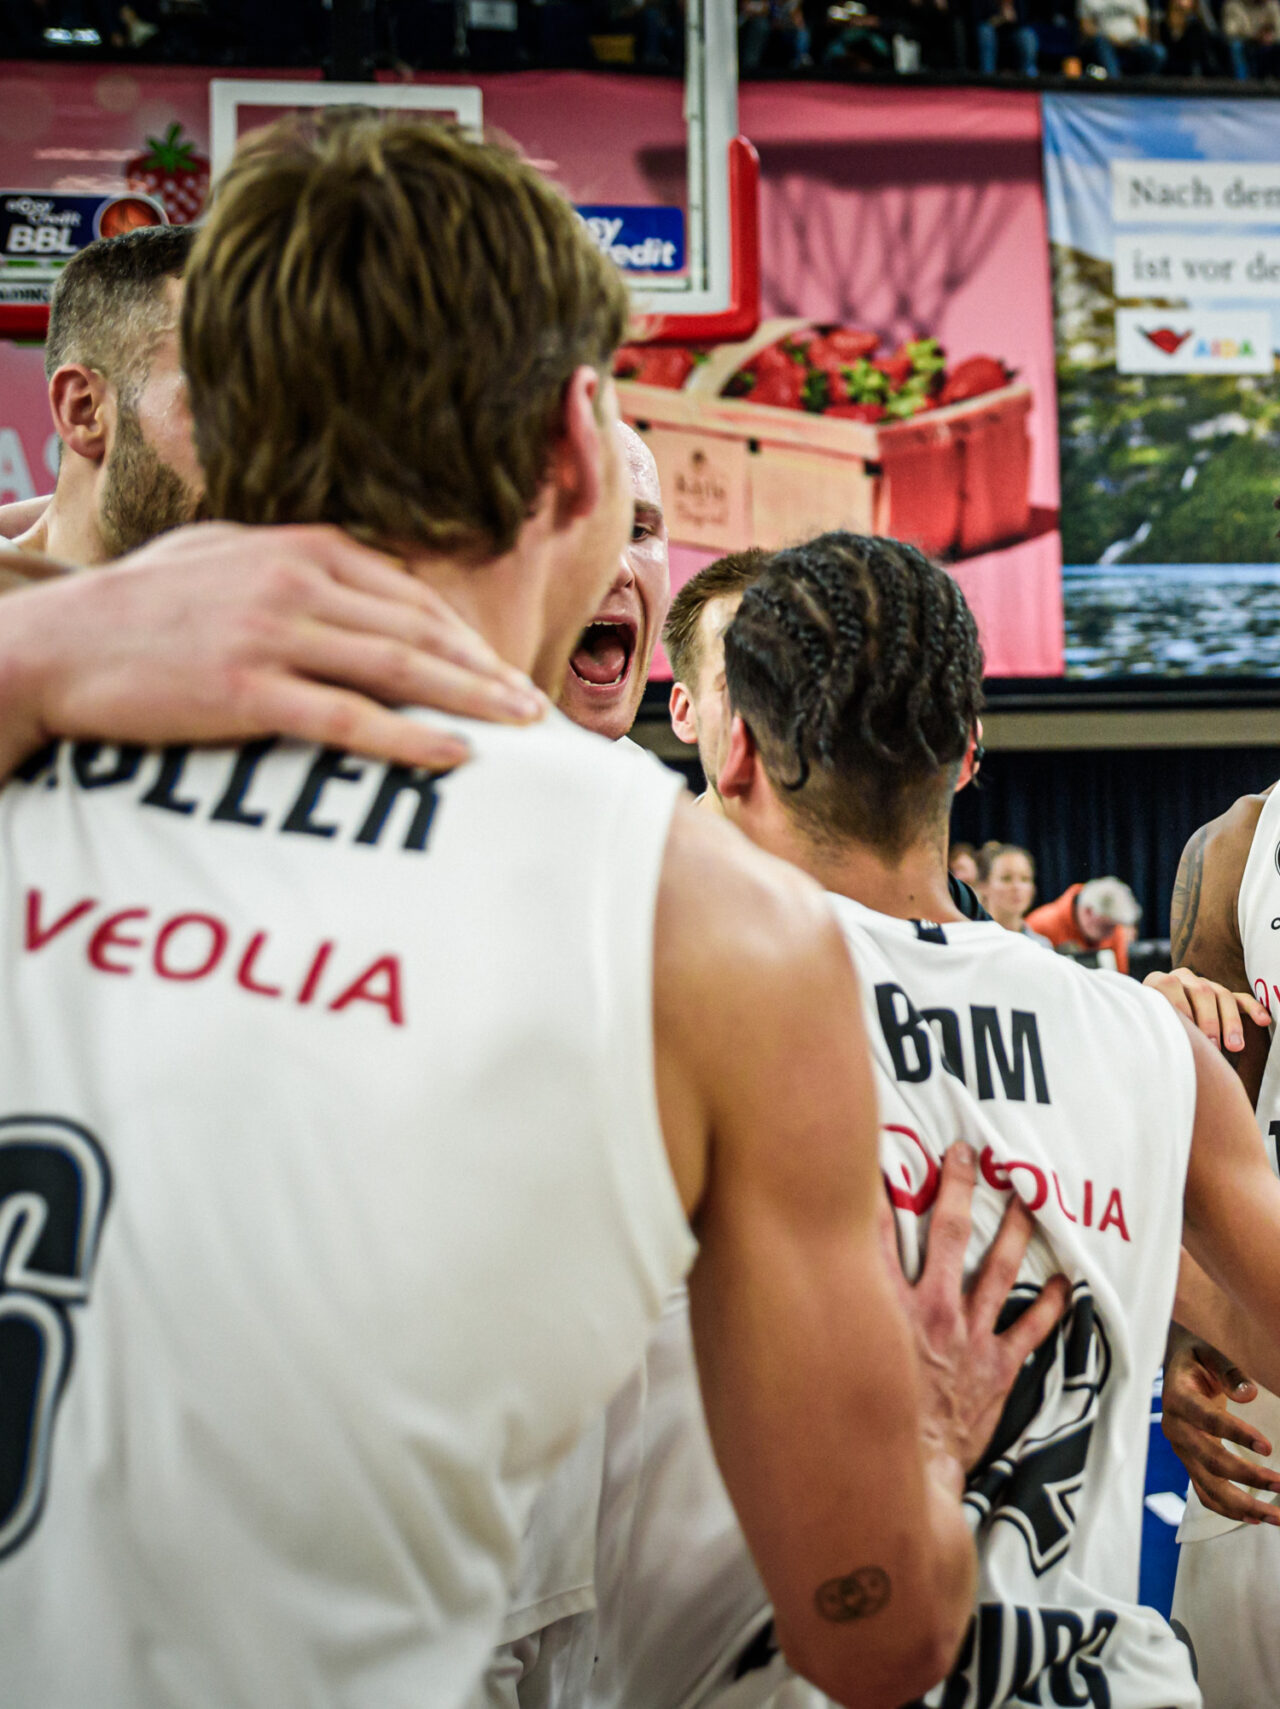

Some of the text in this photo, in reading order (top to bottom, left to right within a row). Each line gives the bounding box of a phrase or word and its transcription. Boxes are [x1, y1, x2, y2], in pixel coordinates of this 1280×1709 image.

[1130, 176, 1213, 209] Nach
[7, 224, 79, 253] BBL
[1133, 249, 1171, 281] ist
[1182, 258, 1233, 281] vor
[1193, 338, 1254, 358] AIDA
[22, 886, 407, 1029] VEOLIA
